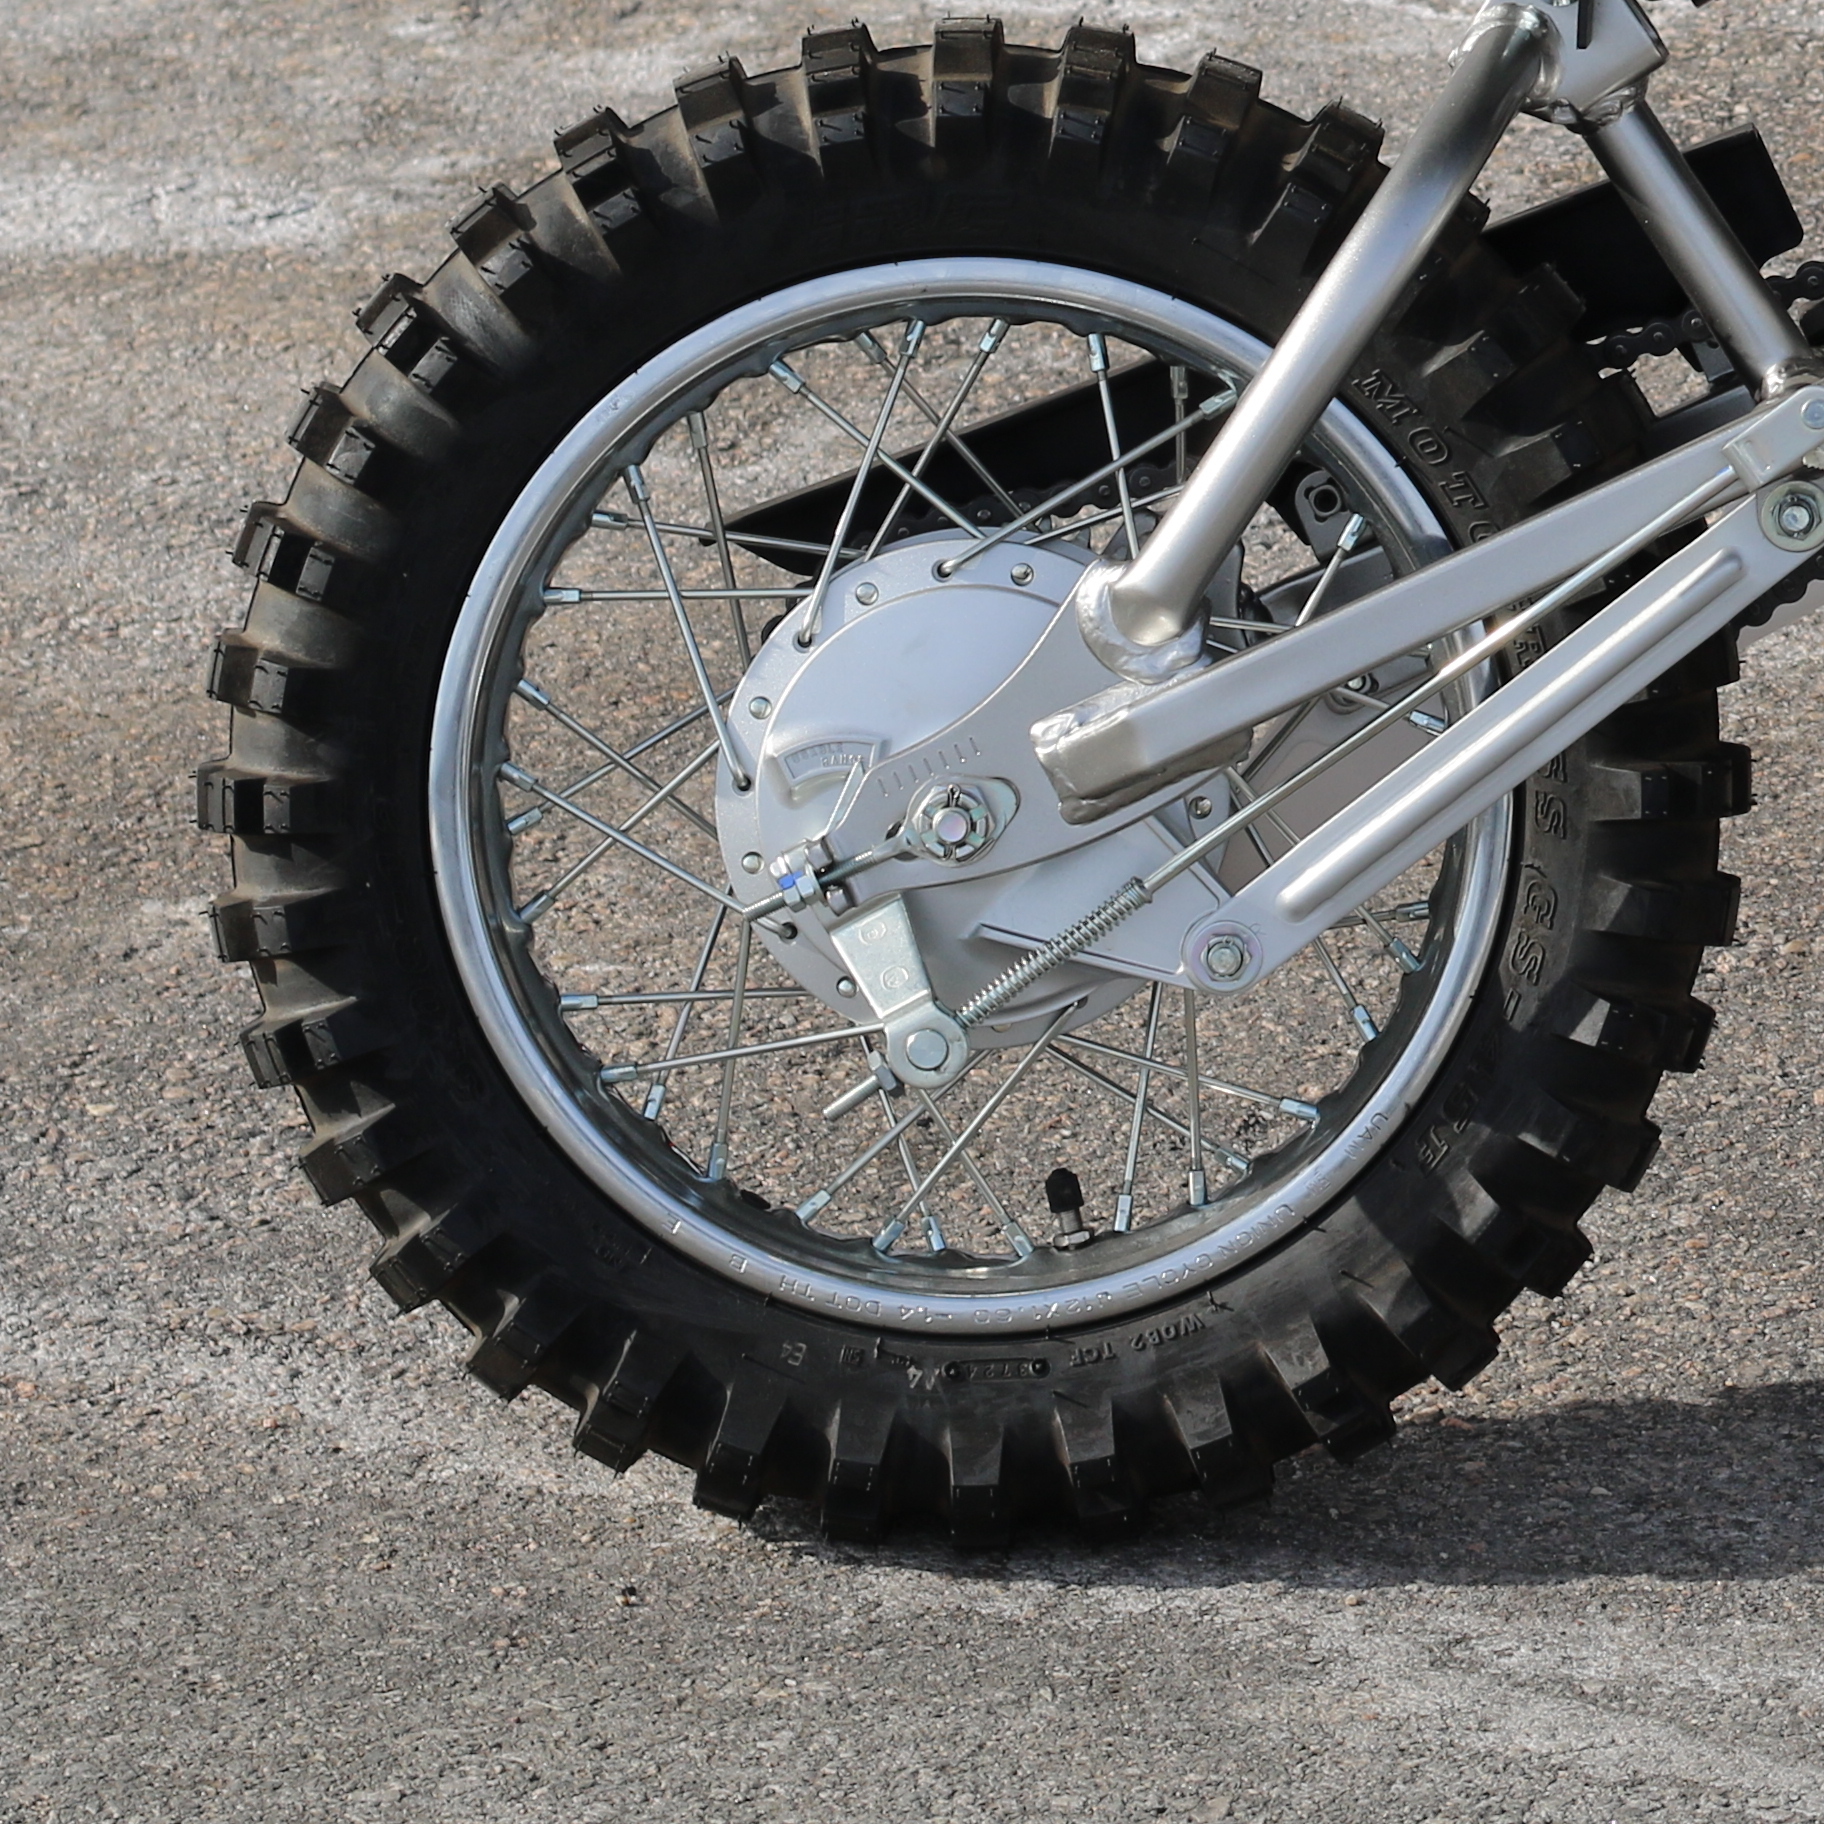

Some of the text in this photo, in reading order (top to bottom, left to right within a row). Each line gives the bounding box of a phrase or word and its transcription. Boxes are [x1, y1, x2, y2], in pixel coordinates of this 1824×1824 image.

[1215, 1199, 1298, 1261] UNION
[1120, 1250, 1215, 1302] CYCLE
[822, 1287, 884, 1319] DOT
[965, 1361, 1028, 1379] 3724
